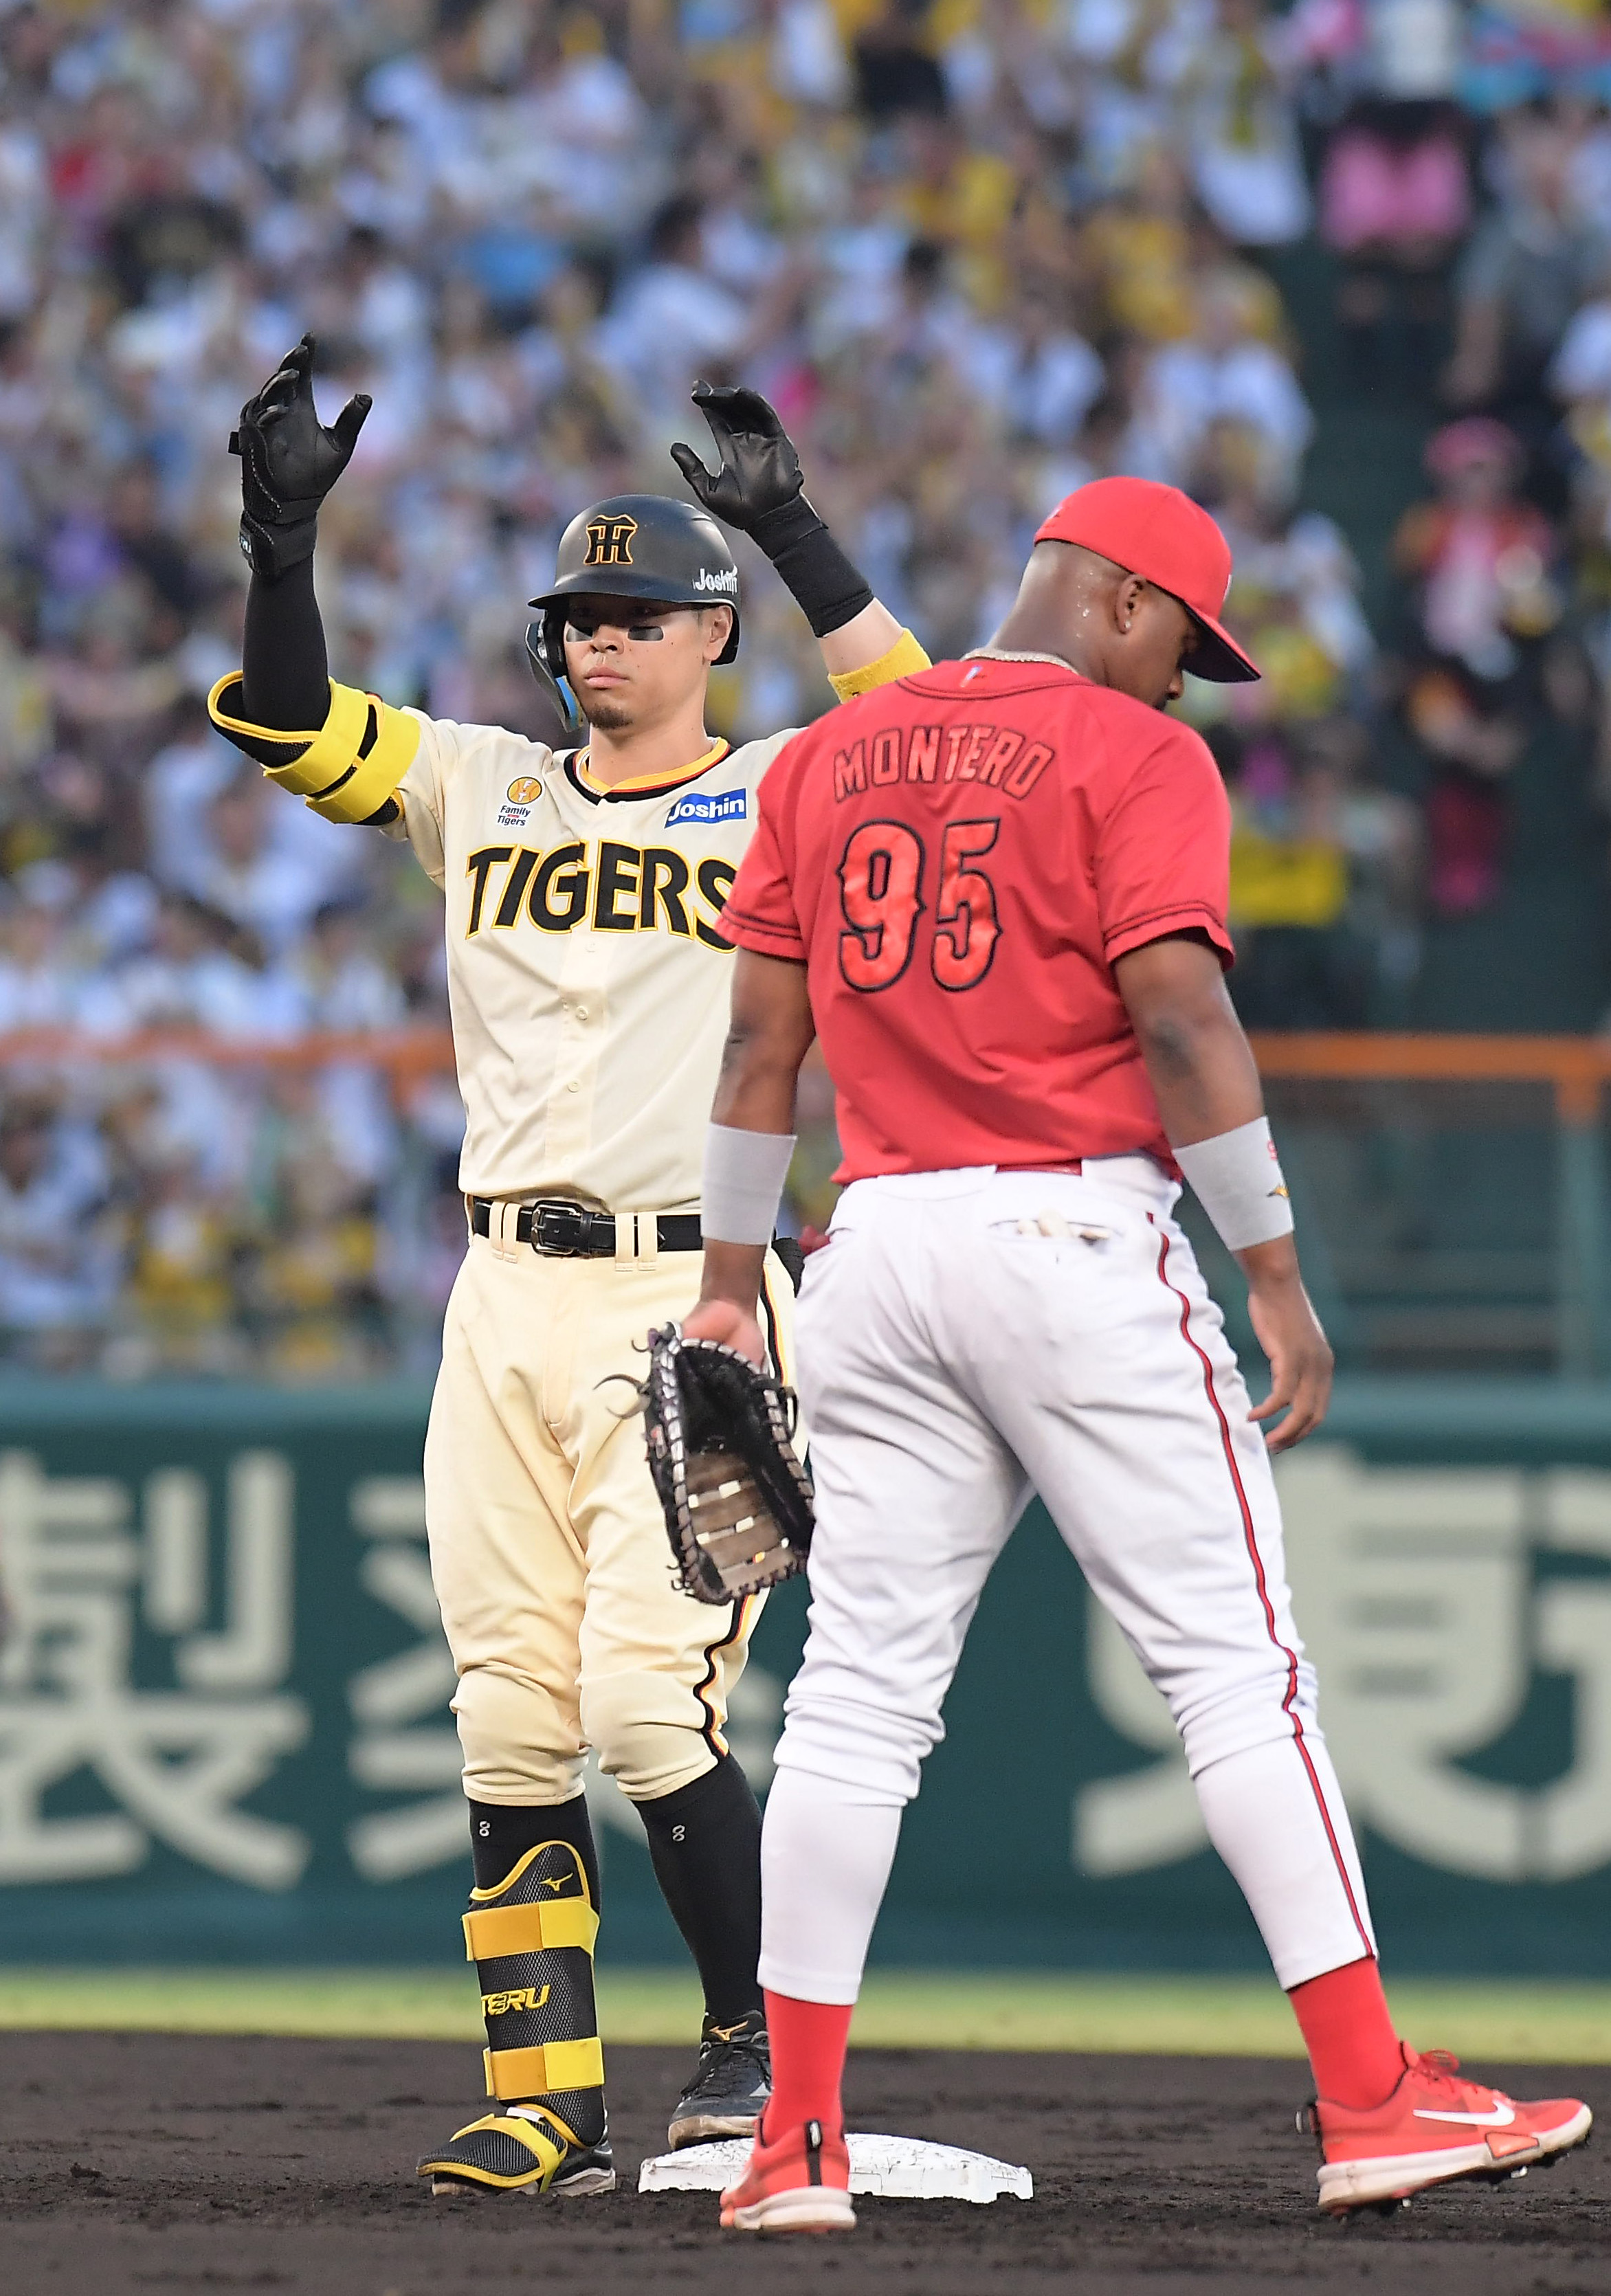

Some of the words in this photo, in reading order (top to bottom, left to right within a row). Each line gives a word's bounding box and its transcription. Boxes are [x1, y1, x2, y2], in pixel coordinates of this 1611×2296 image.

[833, 724, 1056, 803] MONTERO
[497, 814, 526, 826] Tigers
[500, 805, 531, 817] Family
[667, 796, 745, 822] Joshin
[835, 817, 1003, 992] 95
